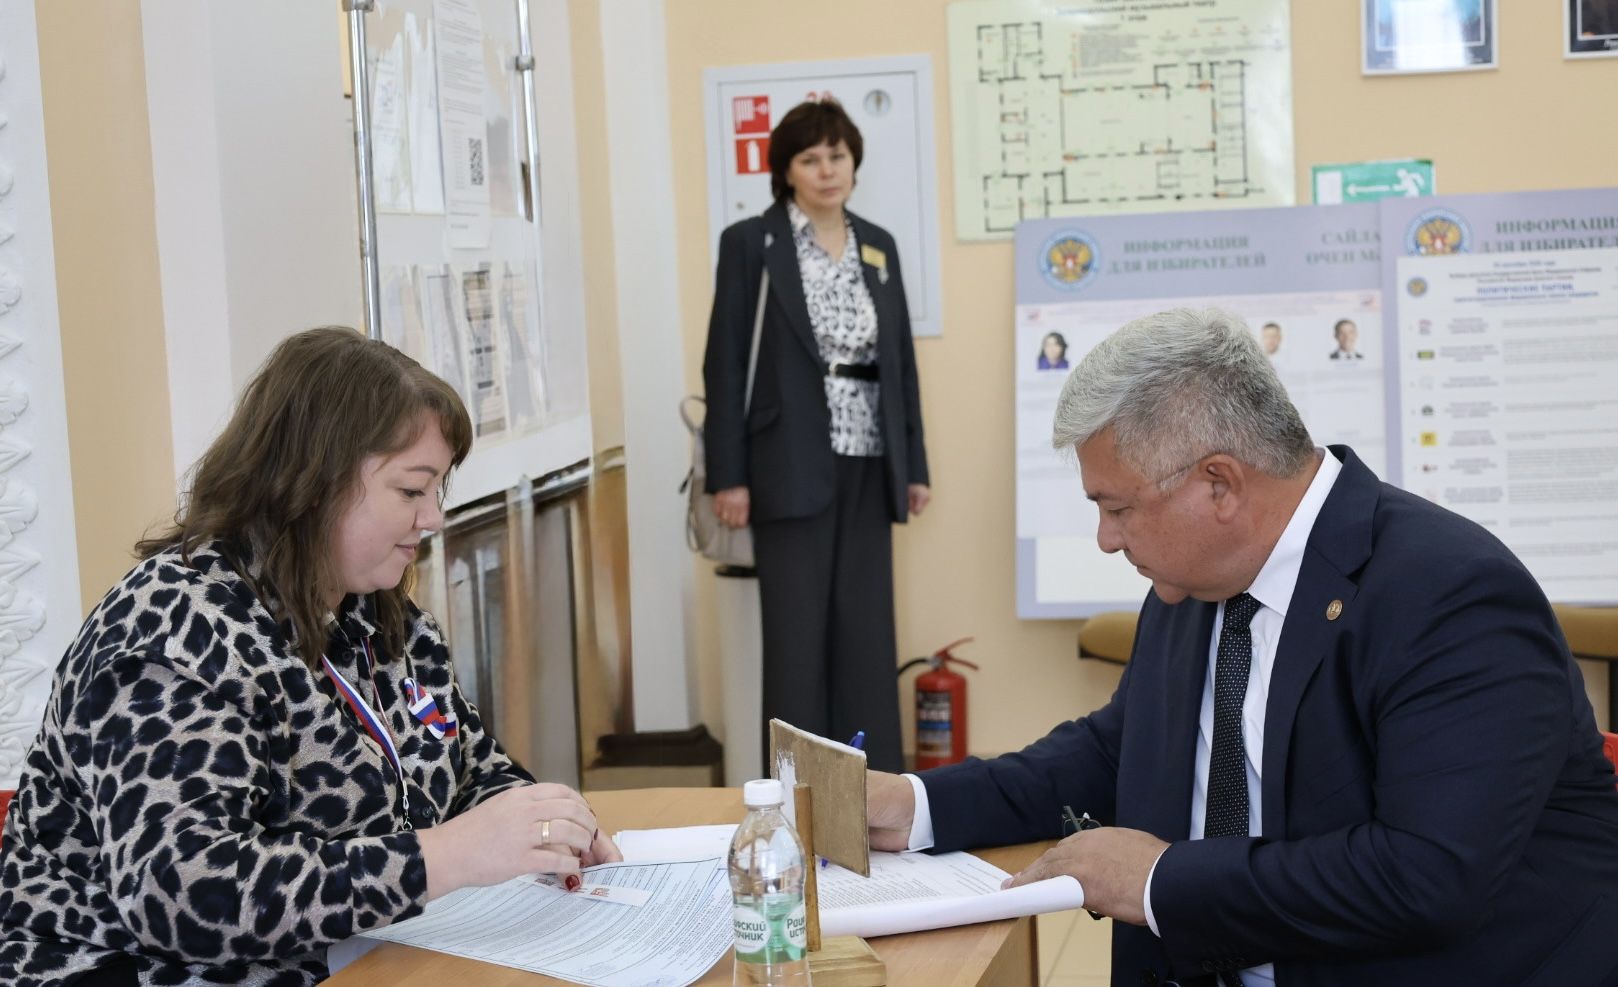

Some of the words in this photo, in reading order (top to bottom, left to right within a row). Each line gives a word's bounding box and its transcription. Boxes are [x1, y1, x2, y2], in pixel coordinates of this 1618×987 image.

[1495, 216, 1618, 233] ИНФОРМАЦИ
[1123, 236, 1249, 253] ИНФОРМАЦИЯ
[1107, 259, 1142, 274] ДЛЯ
[1147, 252, 1266, 271] ИЗБИРАТЕЛЕЙ
